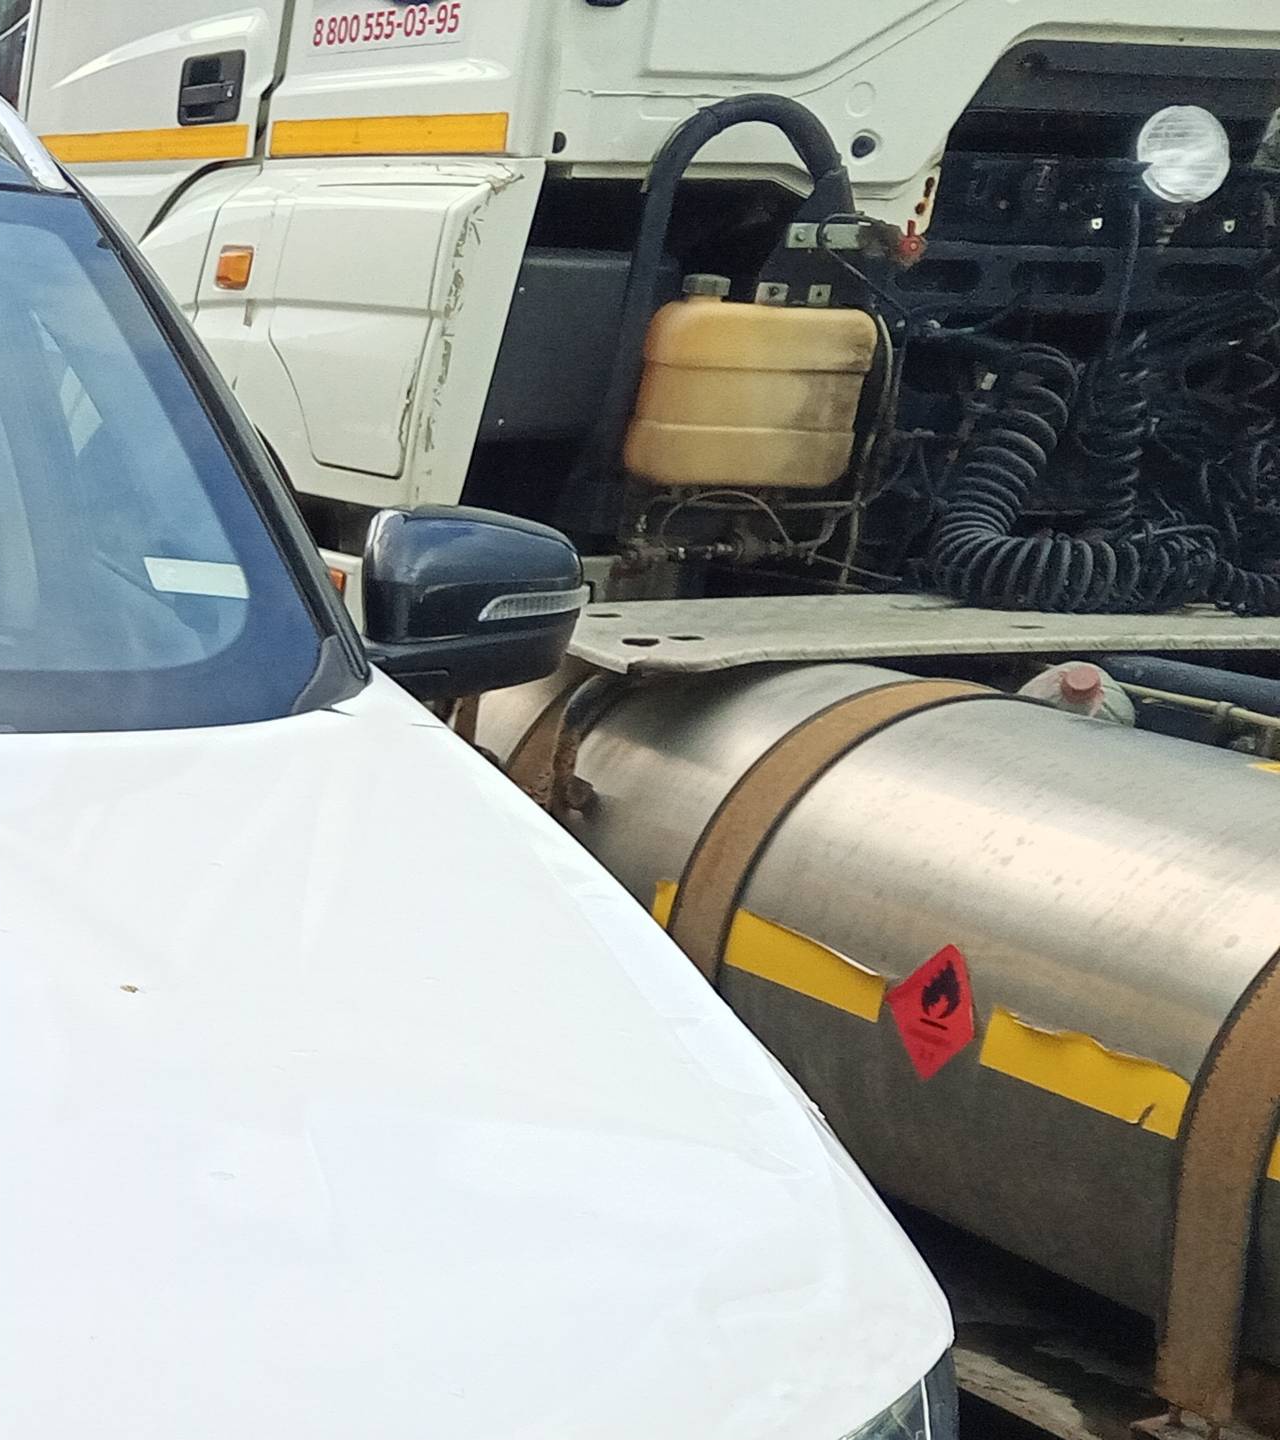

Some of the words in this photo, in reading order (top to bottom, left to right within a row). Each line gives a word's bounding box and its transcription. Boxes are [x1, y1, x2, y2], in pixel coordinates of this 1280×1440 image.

[312, 18, 324, 47] 8
[326, 14, 360, 45] 800
[362, 3, 461, 42] 555-03-95
